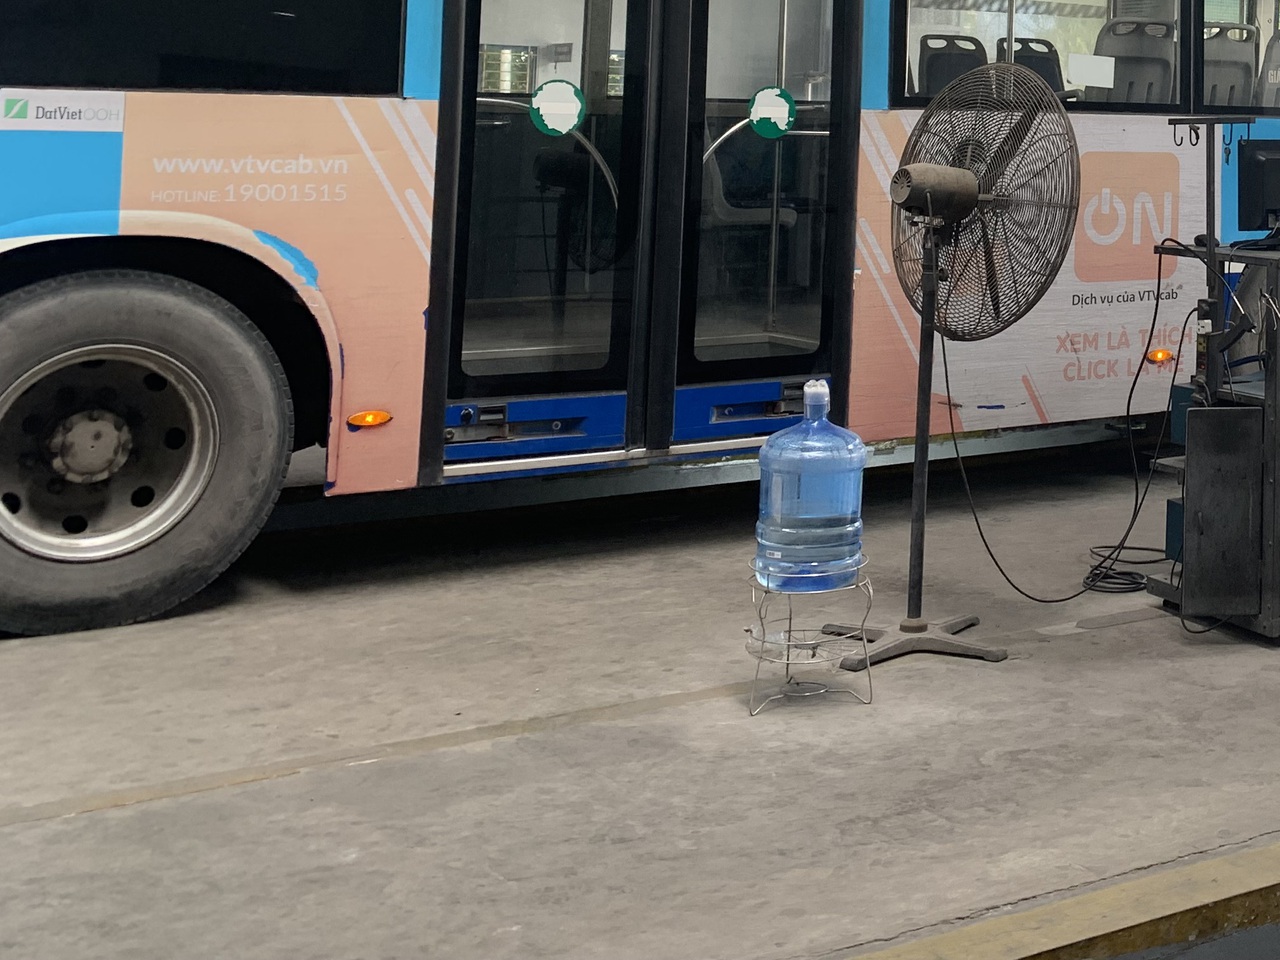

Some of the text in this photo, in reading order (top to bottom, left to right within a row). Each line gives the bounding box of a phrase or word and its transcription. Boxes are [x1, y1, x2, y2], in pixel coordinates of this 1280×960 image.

[153, 153, 348, 175] www.vtvcab.vn
[151, 183, 347, 203] HOTLINE: 19001515
[1072, 293, 1097, 308] Dịch
[1100, 295, 1114, 306] vụ
[1116, 291, 1136, 303] của
[1056, 332, 1099, 353] XEM
[1107, 325, 1131, 350] LÀ
[1063, 359, 1119, 381] CLICK
